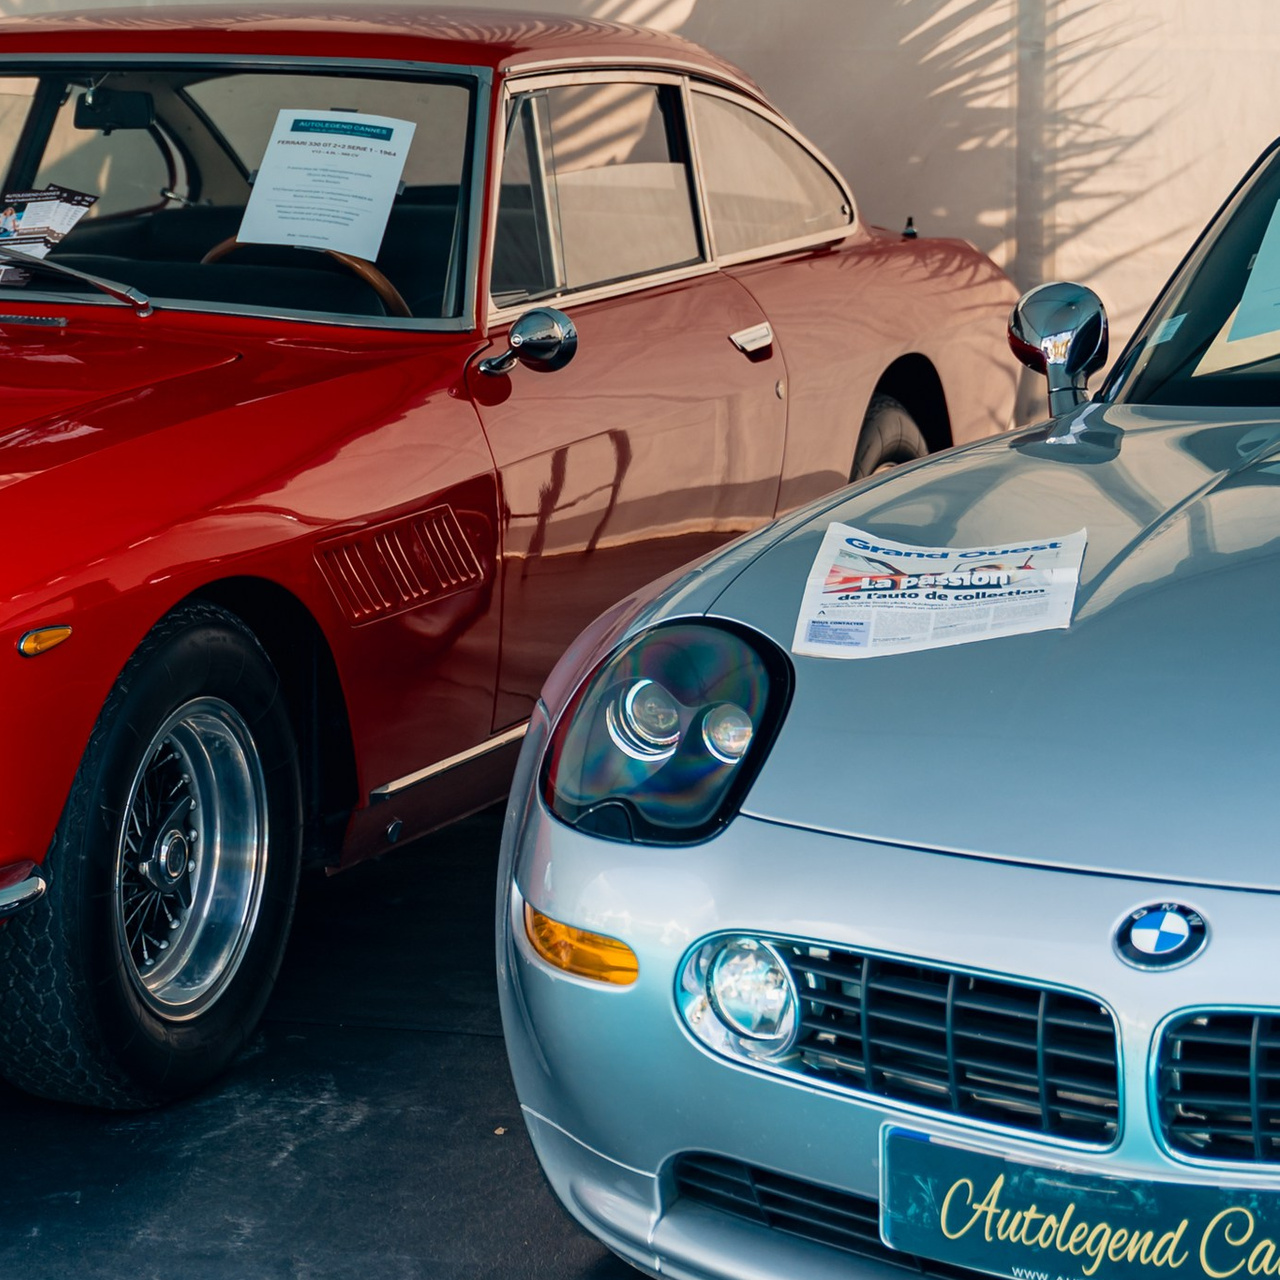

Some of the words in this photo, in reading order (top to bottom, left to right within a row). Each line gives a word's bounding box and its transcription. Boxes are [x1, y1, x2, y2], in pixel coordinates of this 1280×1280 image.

[299, 121, 353, 130] AUTOLEGEND
[354, 126, 388, 135] CANNES
[379, 149, 397, 157] 1964
[845, 537, 949, 559] Grand
[958, 542, 1062, 559] Ouest
[861, 577, 891, 590] La
[899, 571, 1013, 590] passion
[838, 593, 861, 602] de
[925, 591, 948, 602] de
[954, 588, 1046, 602] collection
[1131, 903, 1202, 926] BMW
[940, 1173, 1189, 1276] Autolegend
[1199, 1207, 1280, 1279] Ca
